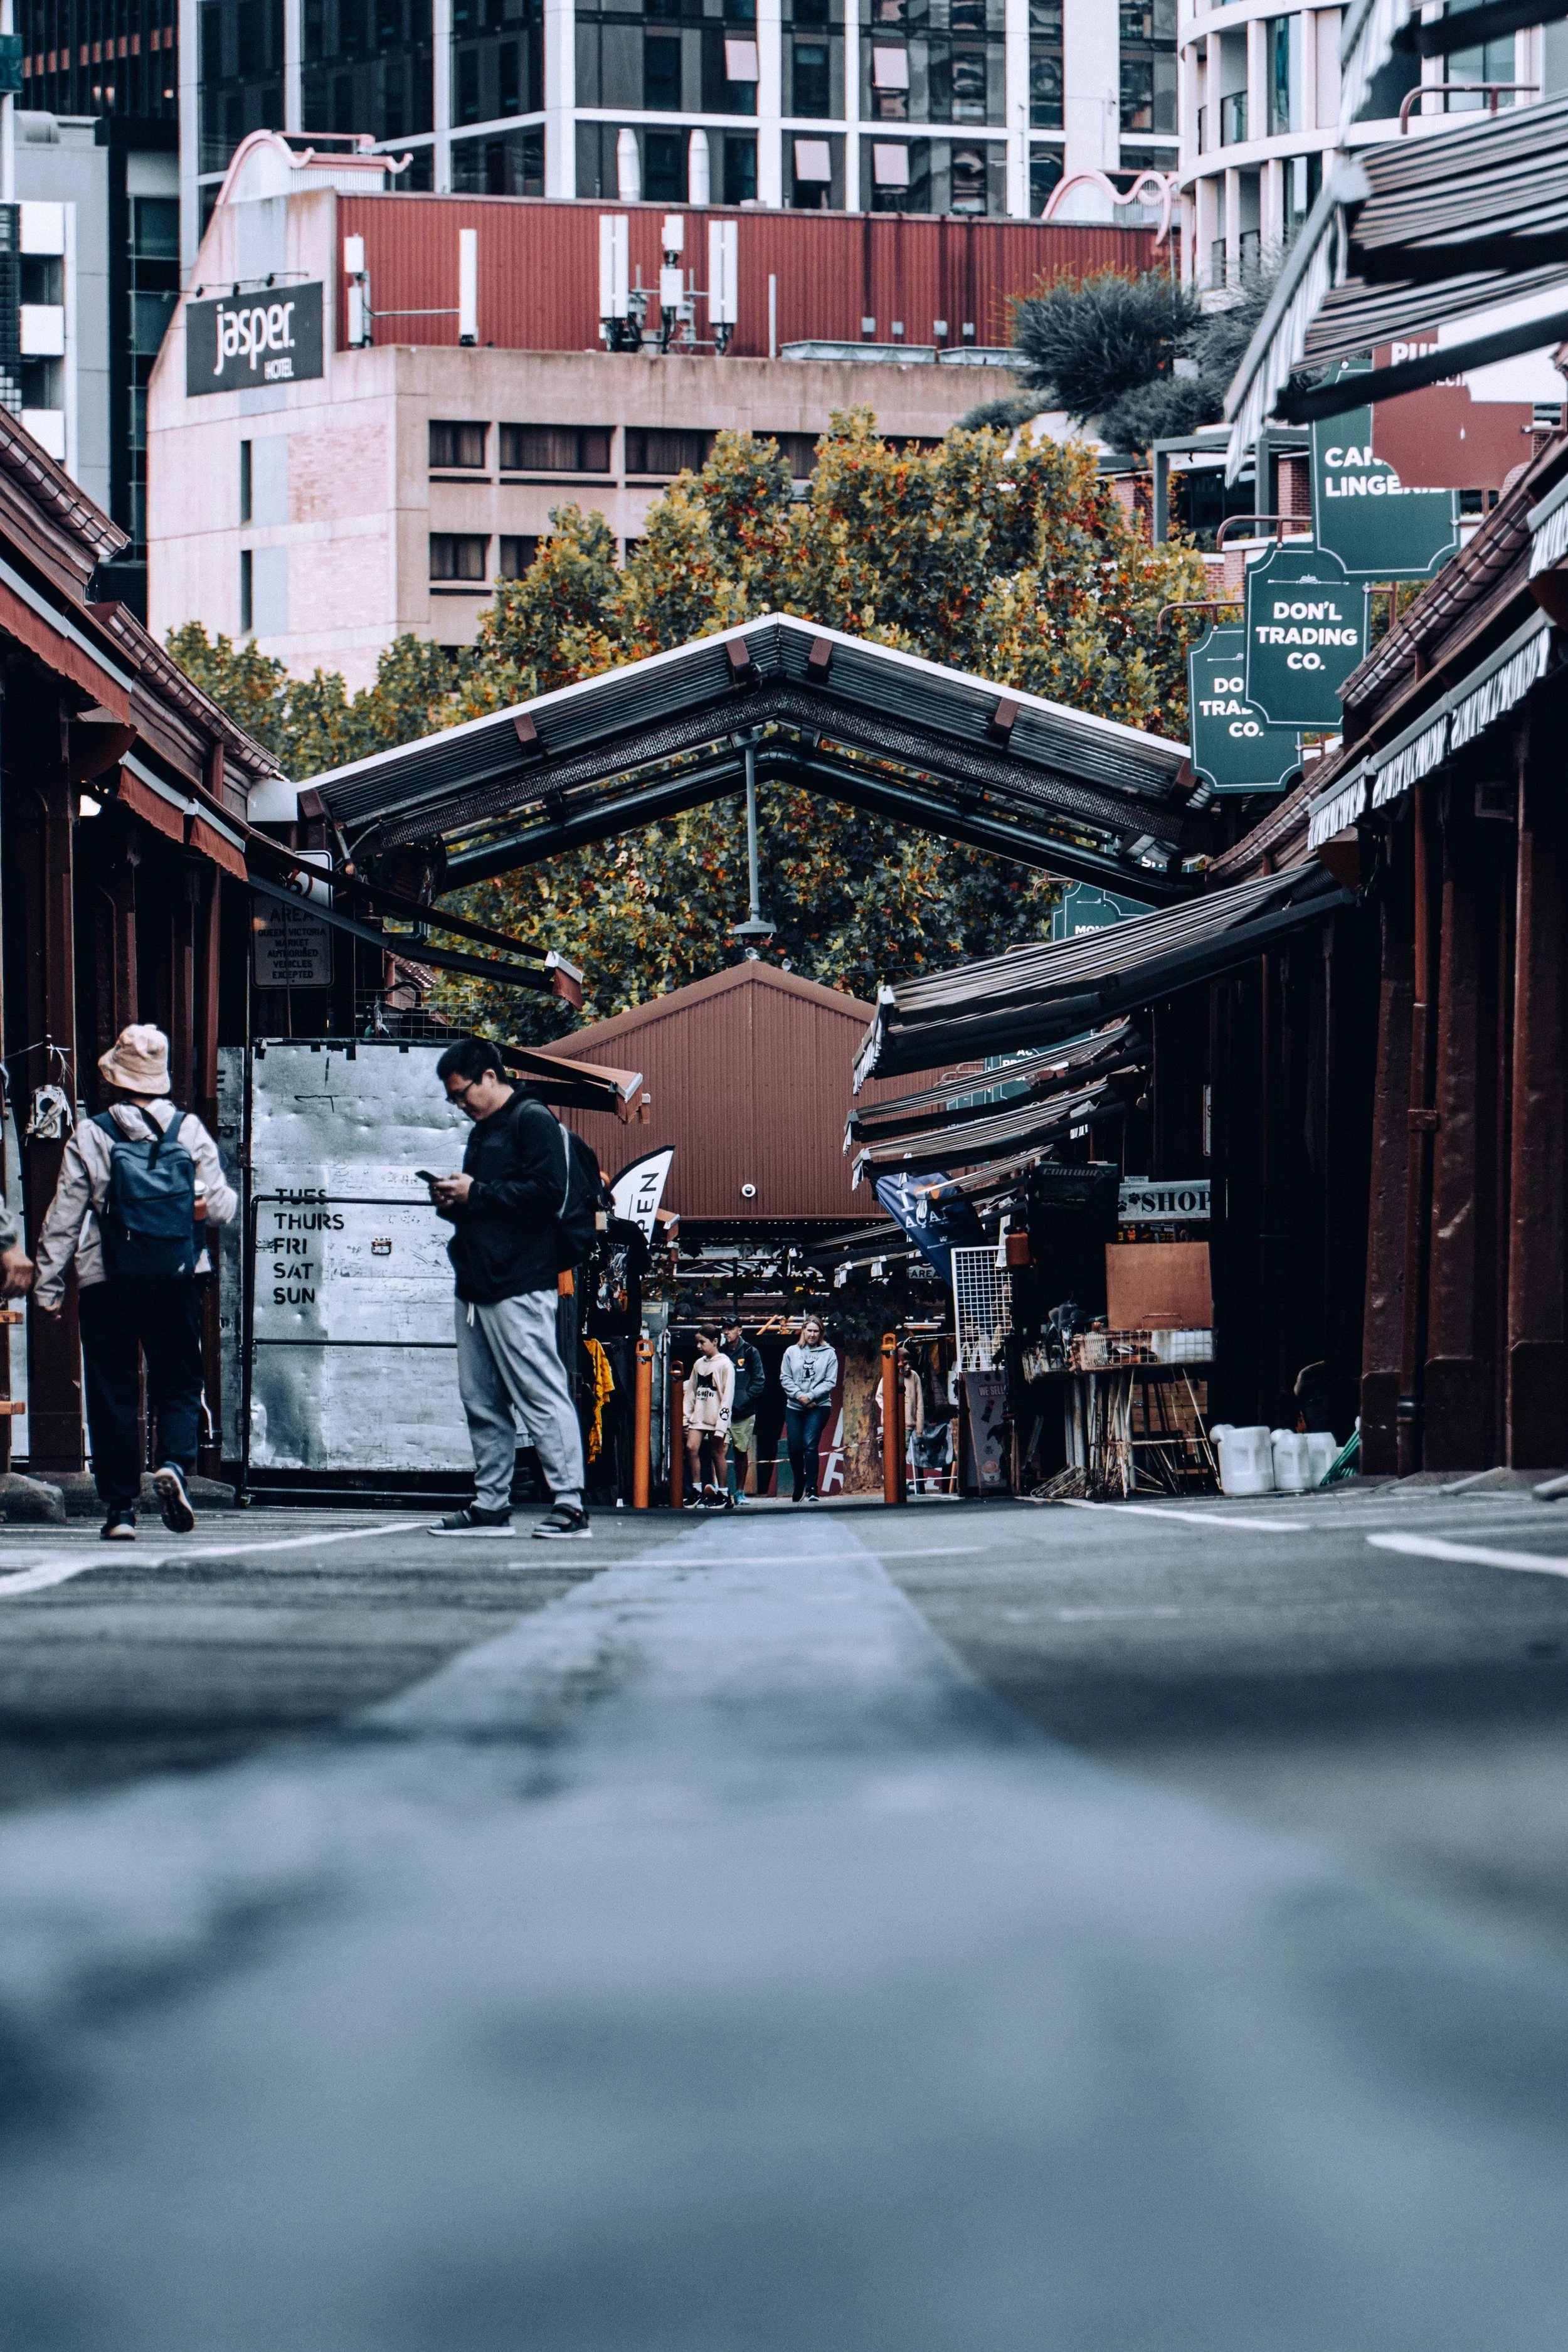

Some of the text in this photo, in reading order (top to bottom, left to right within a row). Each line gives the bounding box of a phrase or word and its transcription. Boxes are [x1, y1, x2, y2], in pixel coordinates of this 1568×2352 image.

[264, 357, 295, 379] HOTEL
[1273, 601, 1343, 621] DON'L
[1255, 626, 1359, 646] TRADING
[1287, 652, 1326, 670] CO.
[1229, 721, 1264, 738] CO.
[289, 928, 326, 936] VICTORIA
[275, 938, 309, 946] MARKET
[273, 960, 312, 968] VEHICLES
[272, 970, 314, 979] EXCEPTED
[273, 1213, 344, 1231] THURS
[273, 1237, 307, 1254] FRI
[273, 1262, 314, 1279] SAT
[273, 1287, 315, 1305] SUN
[978, 1386, 989, 1396] WE
